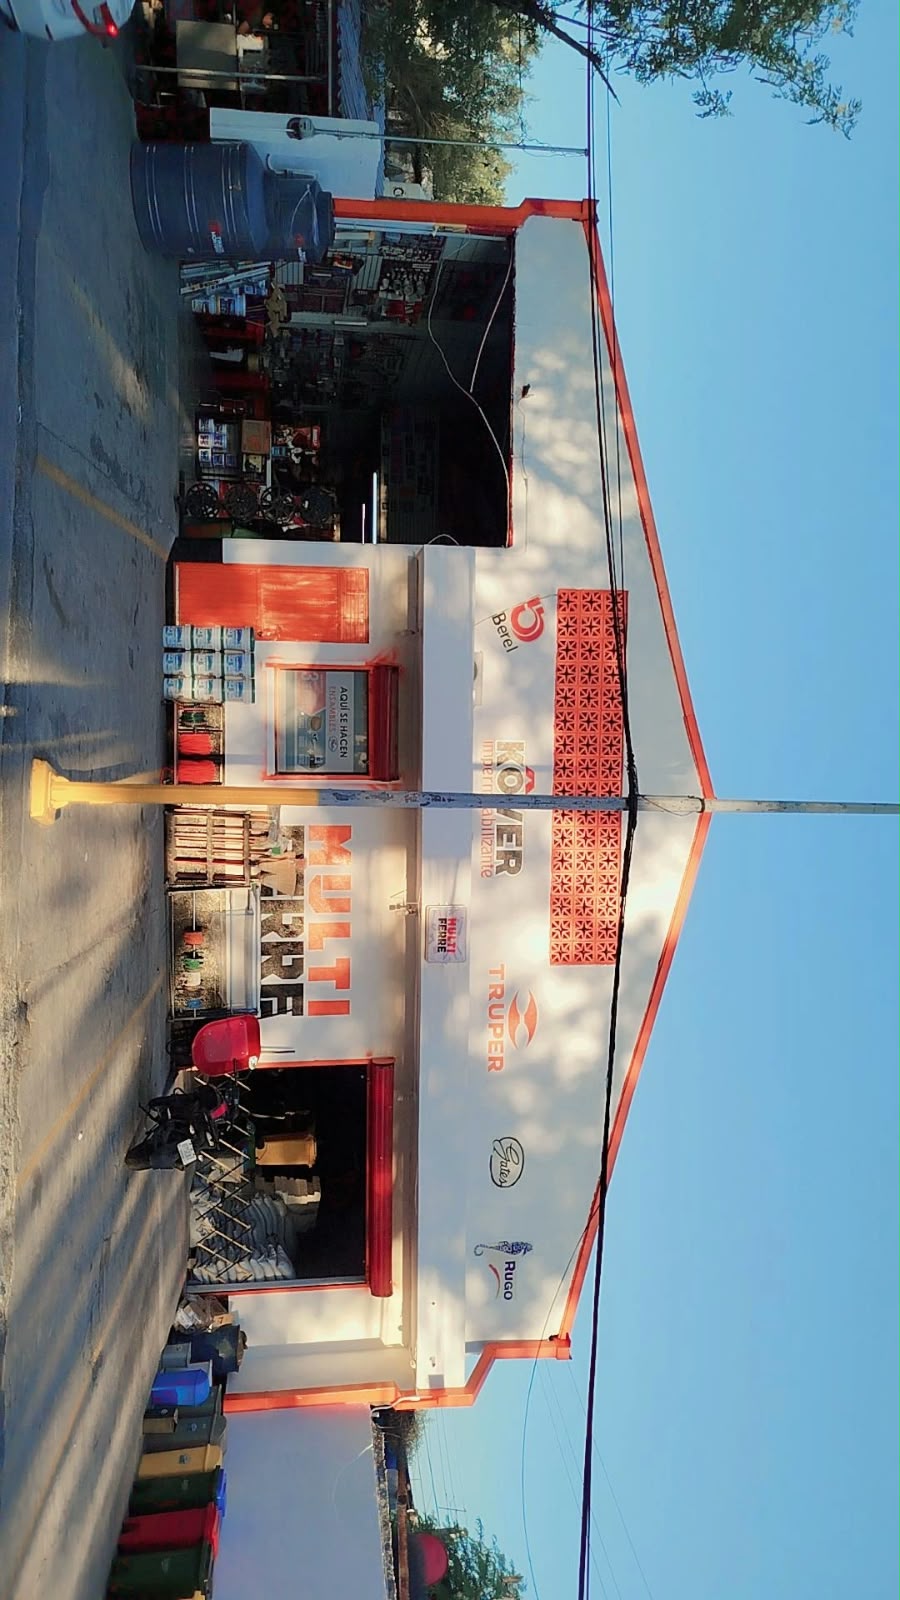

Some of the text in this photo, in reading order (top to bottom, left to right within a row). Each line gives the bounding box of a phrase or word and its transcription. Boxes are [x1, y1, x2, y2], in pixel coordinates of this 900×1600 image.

[492, 612, 519, 652] Berel
[340, 687, 350, 758] AQUÍ SE HACEN
[481, 741, 496, 878] impermabilizante
[308, 825, 352, 1016] MULTI
[438, 918, 447, 952] FERRE
[447, 918, 457, 953] MULTI
[488, 965, 505, 1072] TRUPER
[493, 1140, 520, 1187] Gates
